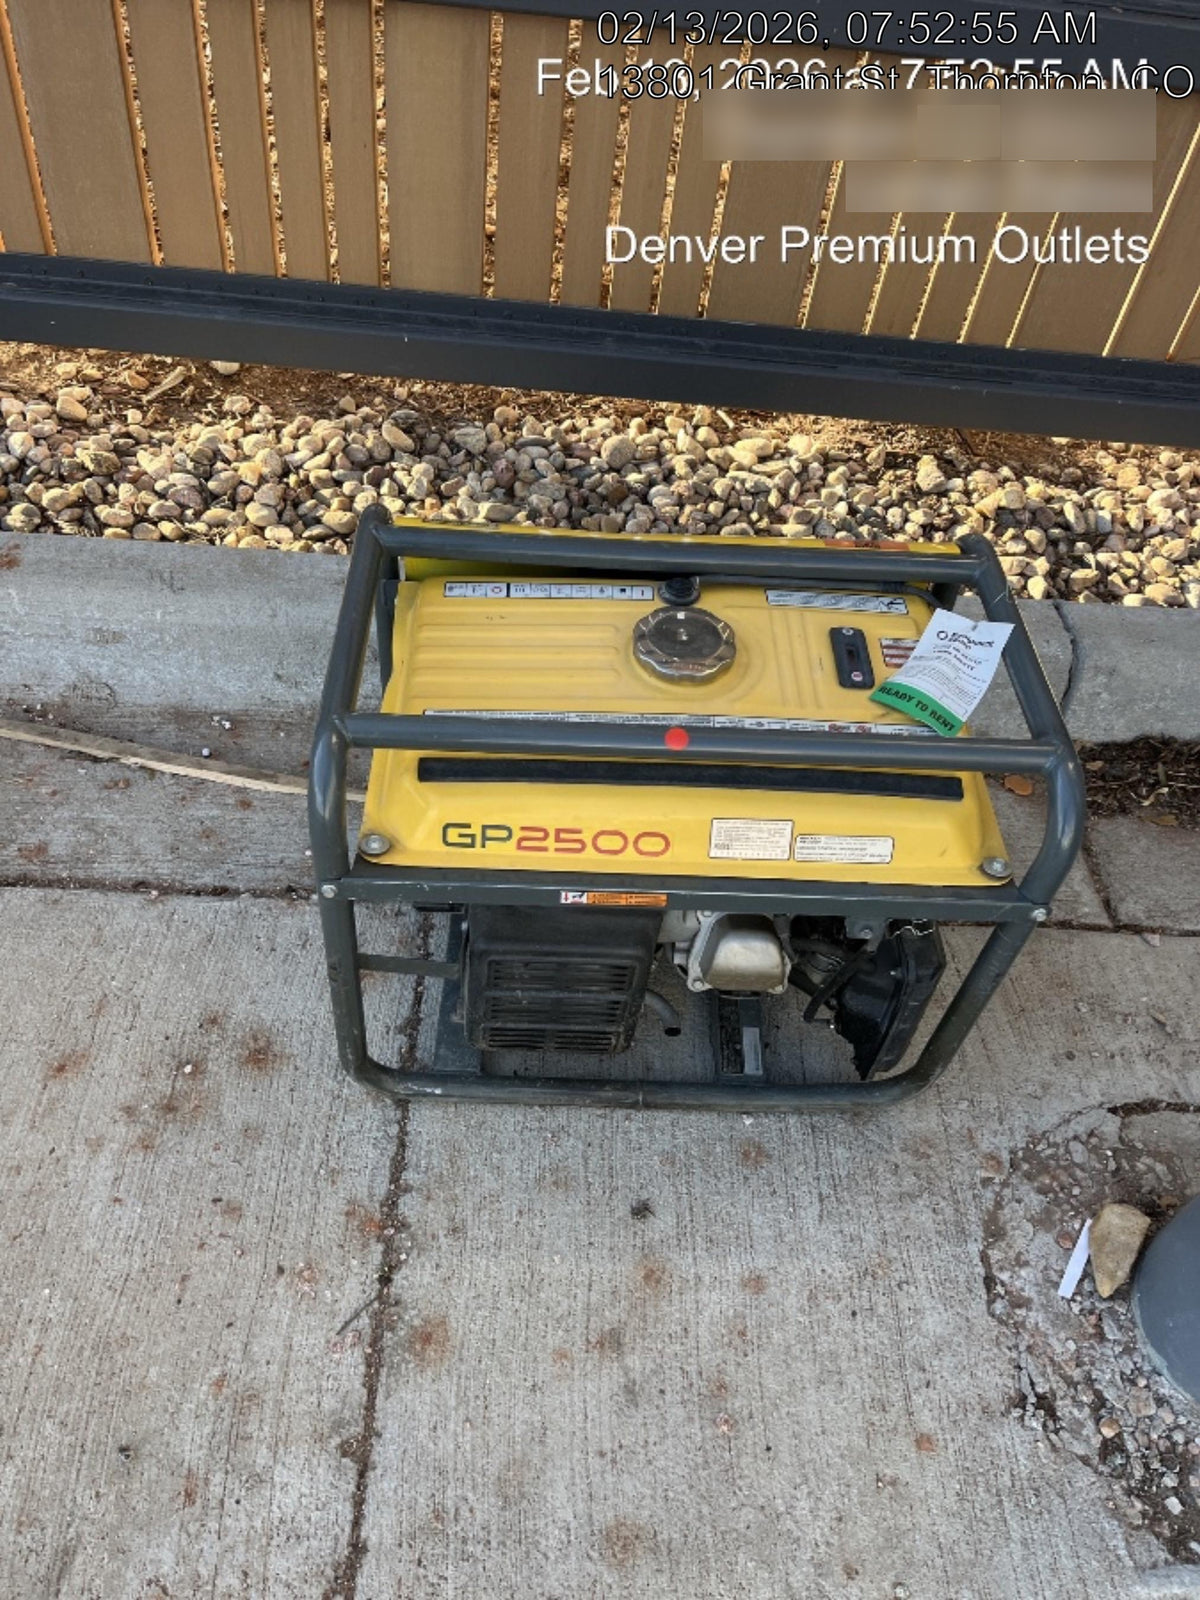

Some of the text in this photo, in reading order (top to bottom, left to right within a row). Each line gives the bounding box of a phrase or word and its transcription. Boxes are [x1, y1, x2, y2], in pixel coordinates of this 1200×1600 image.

[878, 686, 956, 731] READY TO RENT
[442, 822, 672, 858] GP2500
